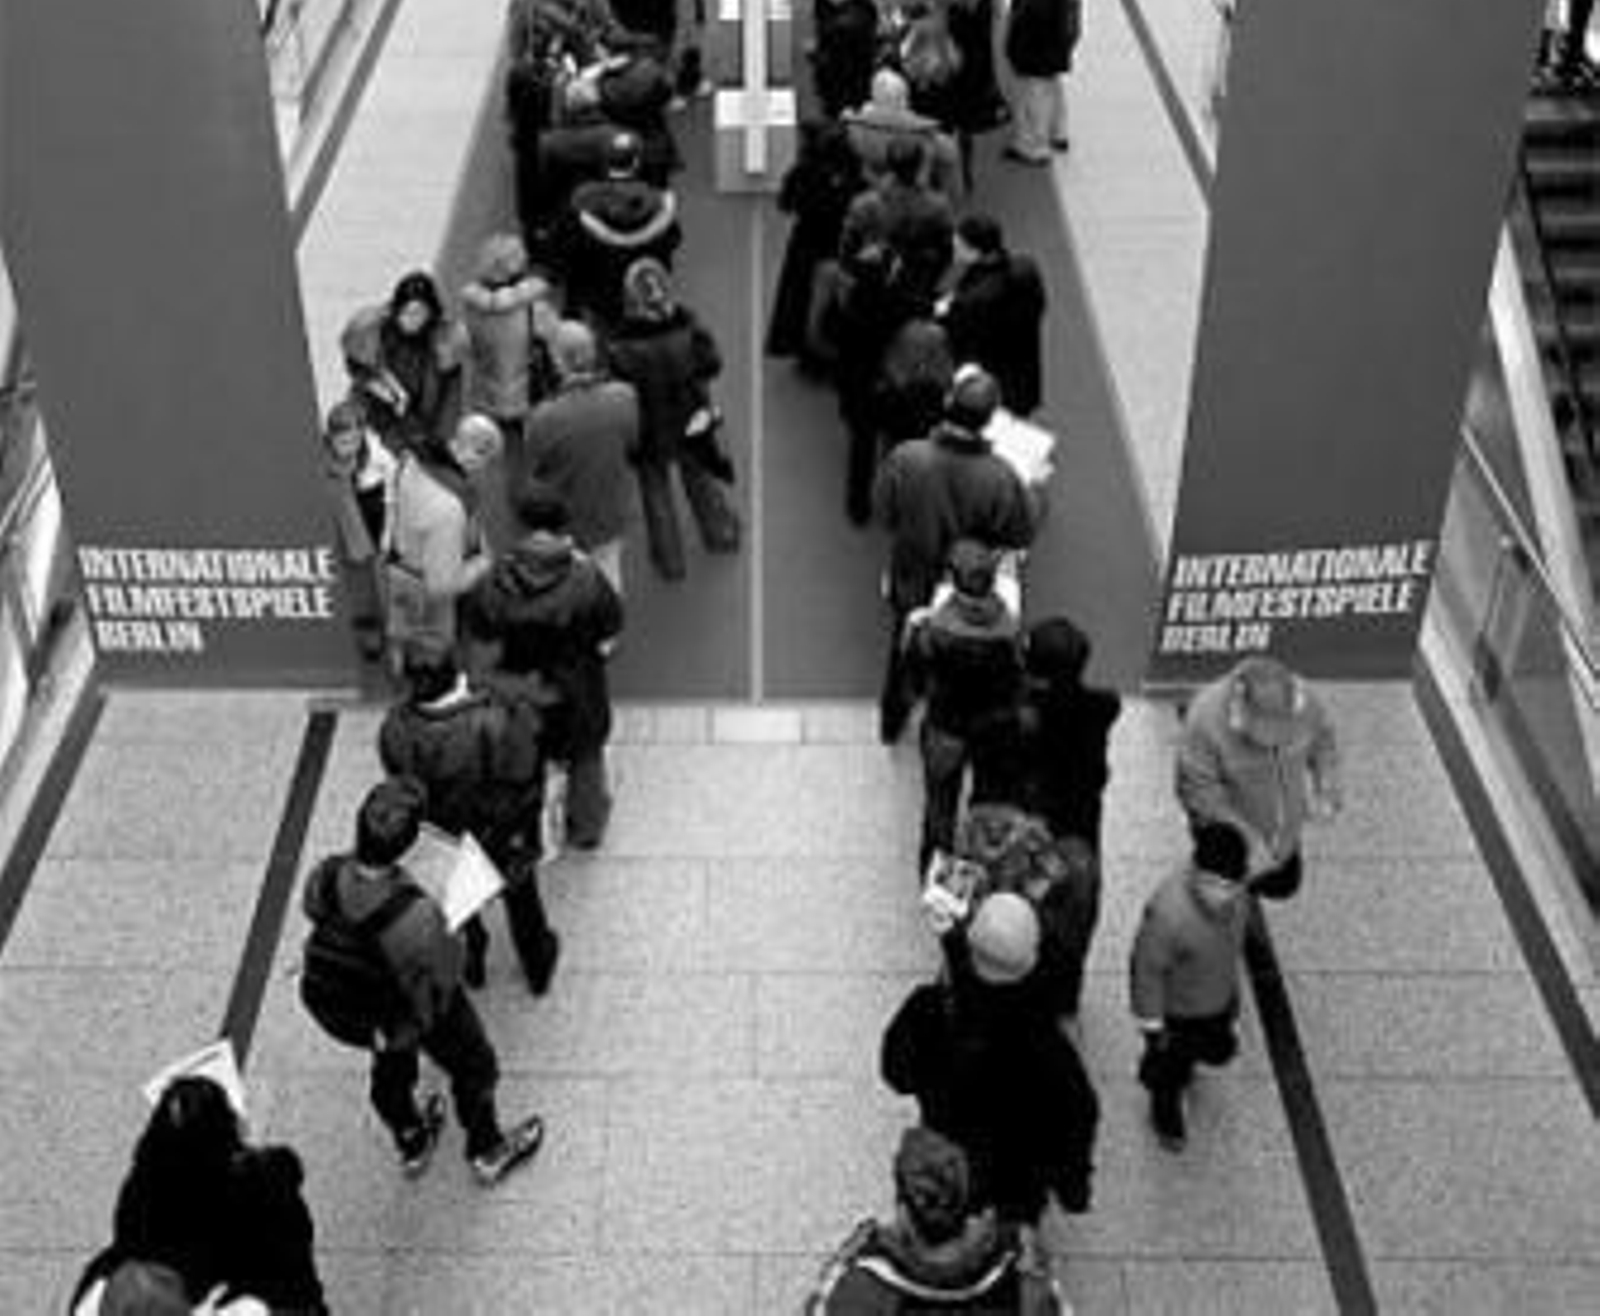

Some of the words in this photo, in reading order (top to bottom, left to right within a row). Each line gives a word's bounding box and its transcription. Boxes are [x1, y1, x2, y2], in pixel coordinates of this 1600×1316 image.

[78, 547, 337, 582] INTERNATIONALE
[1173, 540, 1432, 589] INTERNATIONALE
[86, 584, 334, 618] FILMFESTSPIELE
[1167, 582, 1413, 622] FILMFESTSPIELE
[95, 621, 204, 652] BERLIN
[1161, 623, 1272, 653] BERLIN
